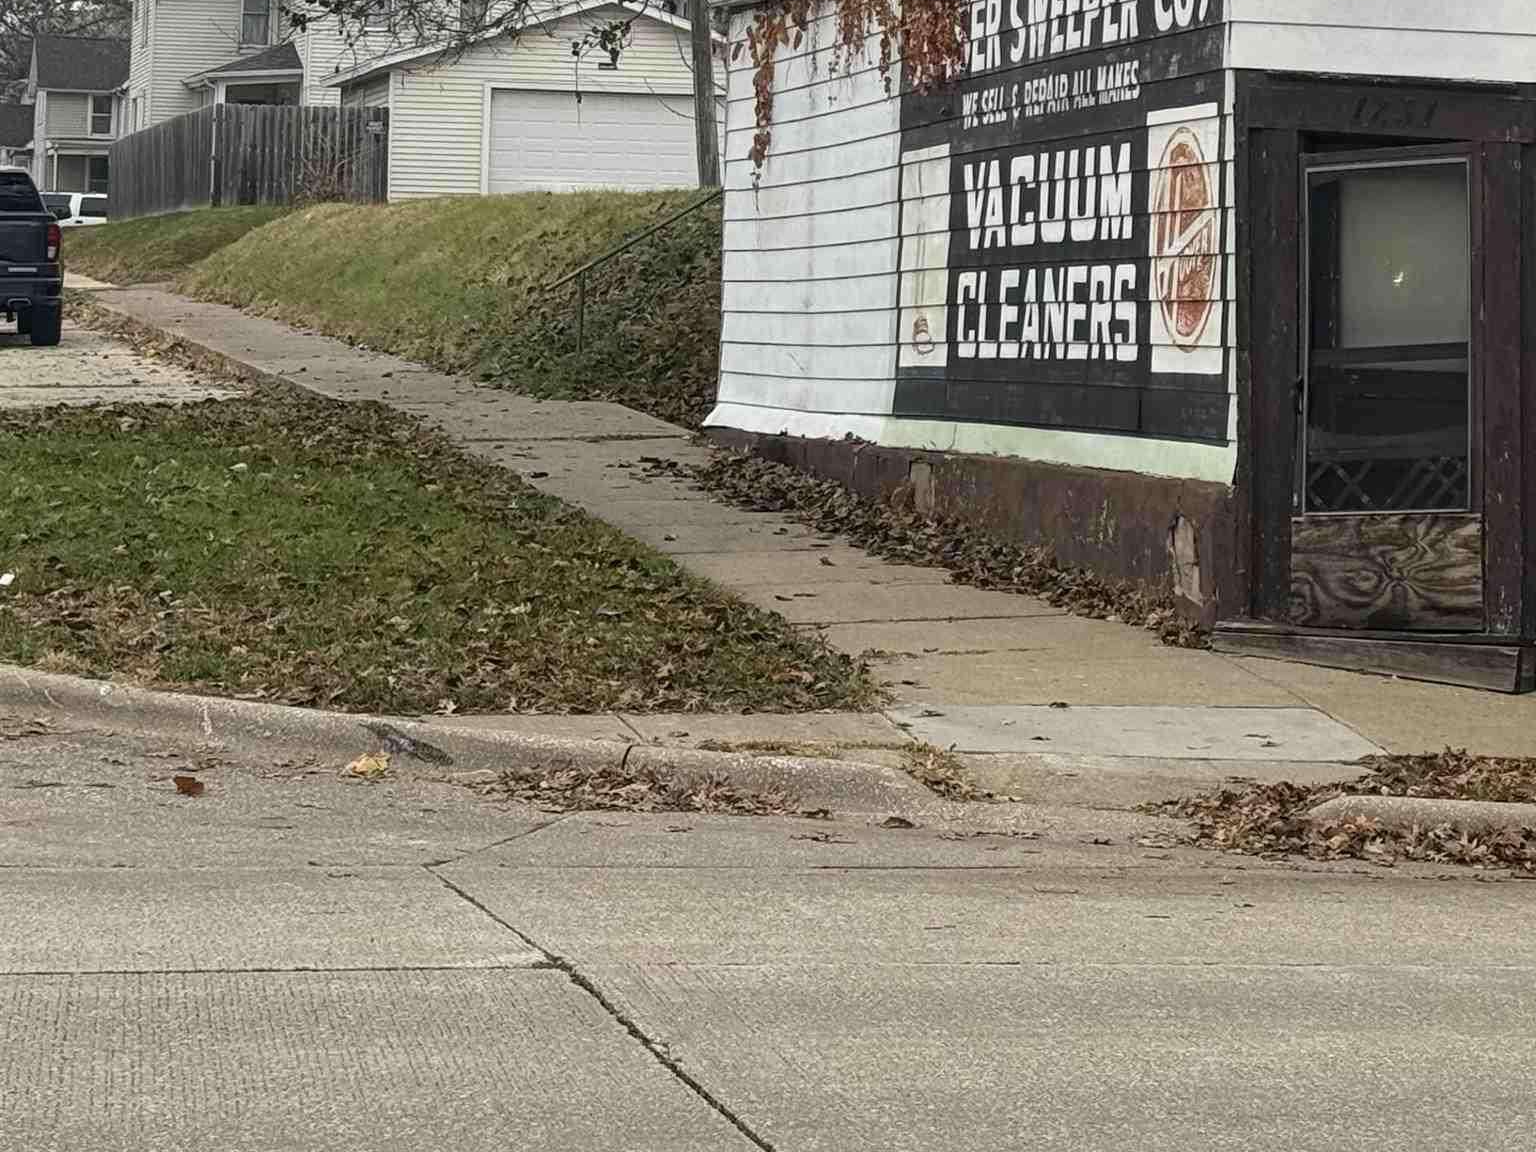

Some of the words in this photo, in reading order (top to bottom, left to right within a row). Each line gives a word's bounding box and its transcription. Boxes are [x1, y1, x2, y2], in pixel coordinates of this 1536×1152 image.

[962, 91, 979, 130] WE
[981, 86, 1007, 125] SELL
[1024, 73, 1071, 117] REPAIR
[1072, 68, 1096, 110] ALL
[1097, 60, 1141, 105] MAKES
[963, 142, 1133, 250] VACUUM
[957, 263, 1138, 362] CLEANERS
